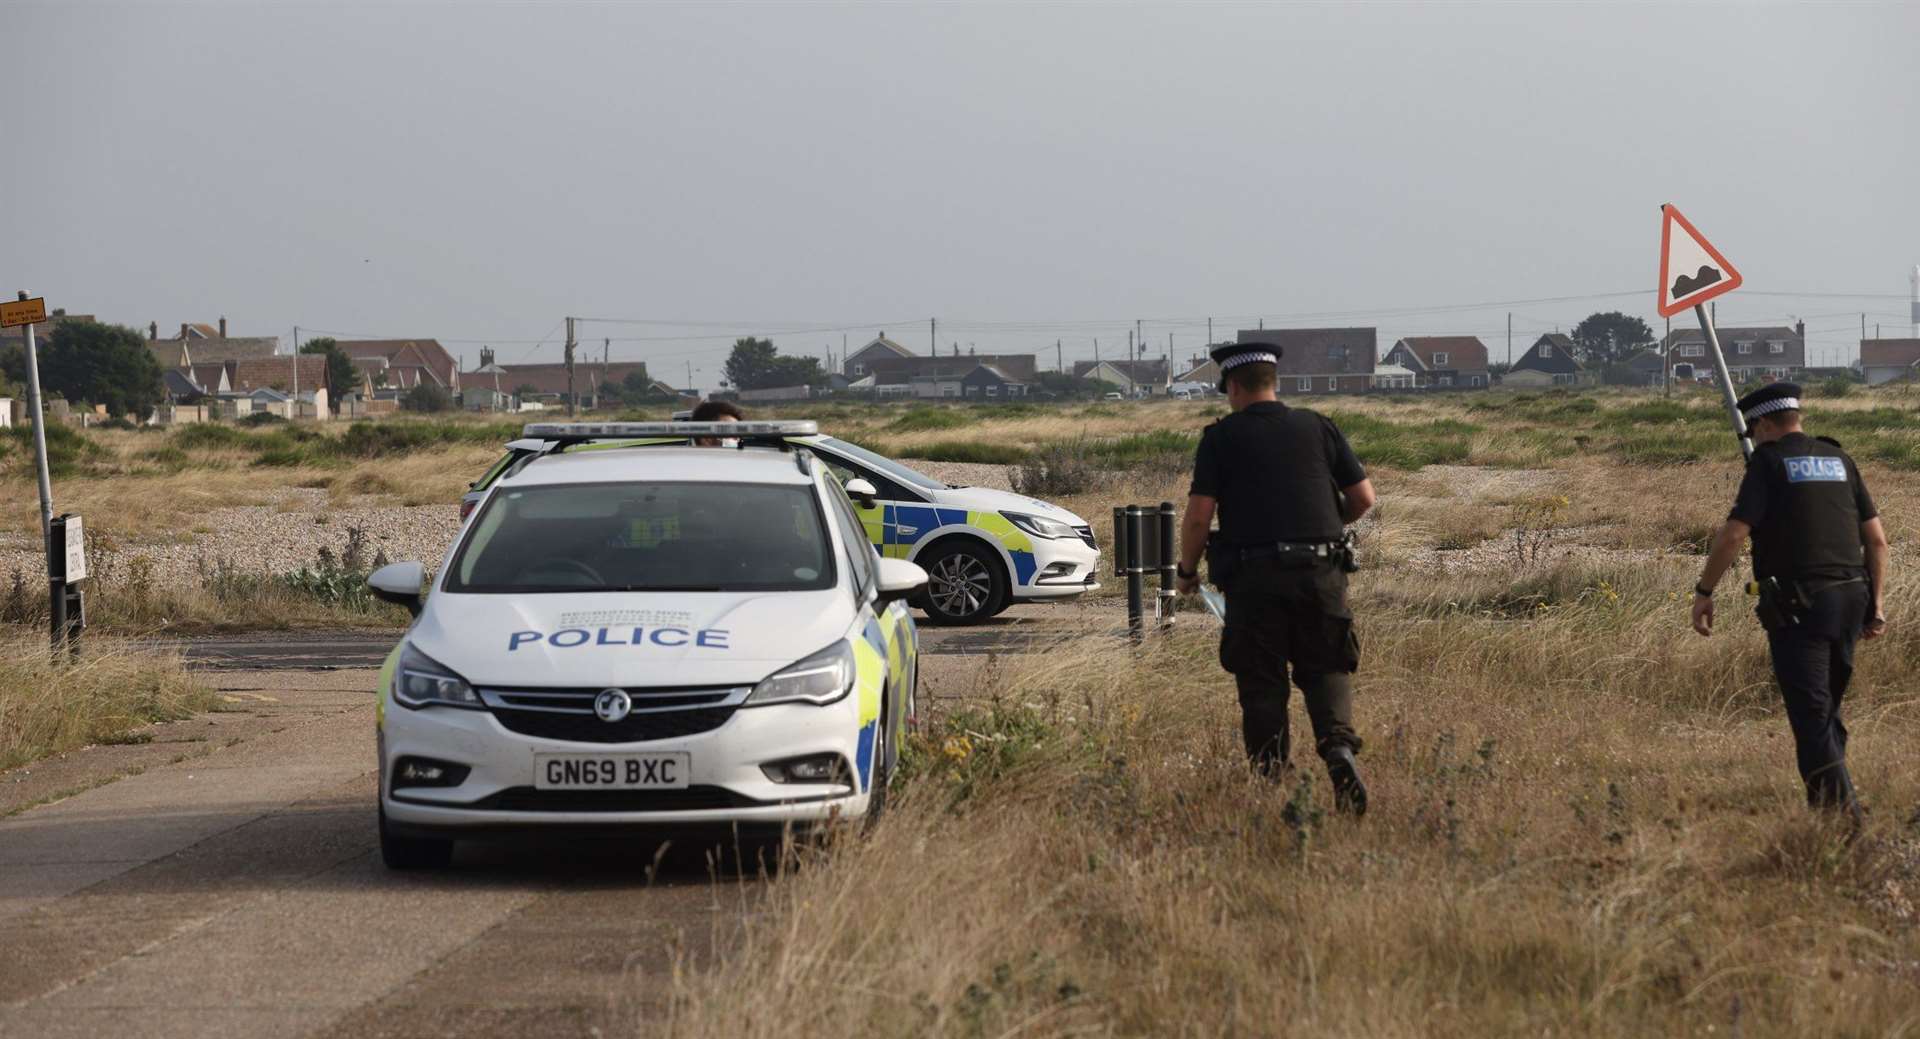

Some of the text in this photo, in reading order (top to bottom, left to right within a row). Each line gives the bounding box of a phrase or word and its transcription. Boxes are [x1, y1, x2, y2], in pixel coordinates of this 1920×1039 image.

[1788, 460, 1844, 478] POLICE
[508, 627, 730, 651] POLICE
[546, 759, 677, 785] GN69 BXC
